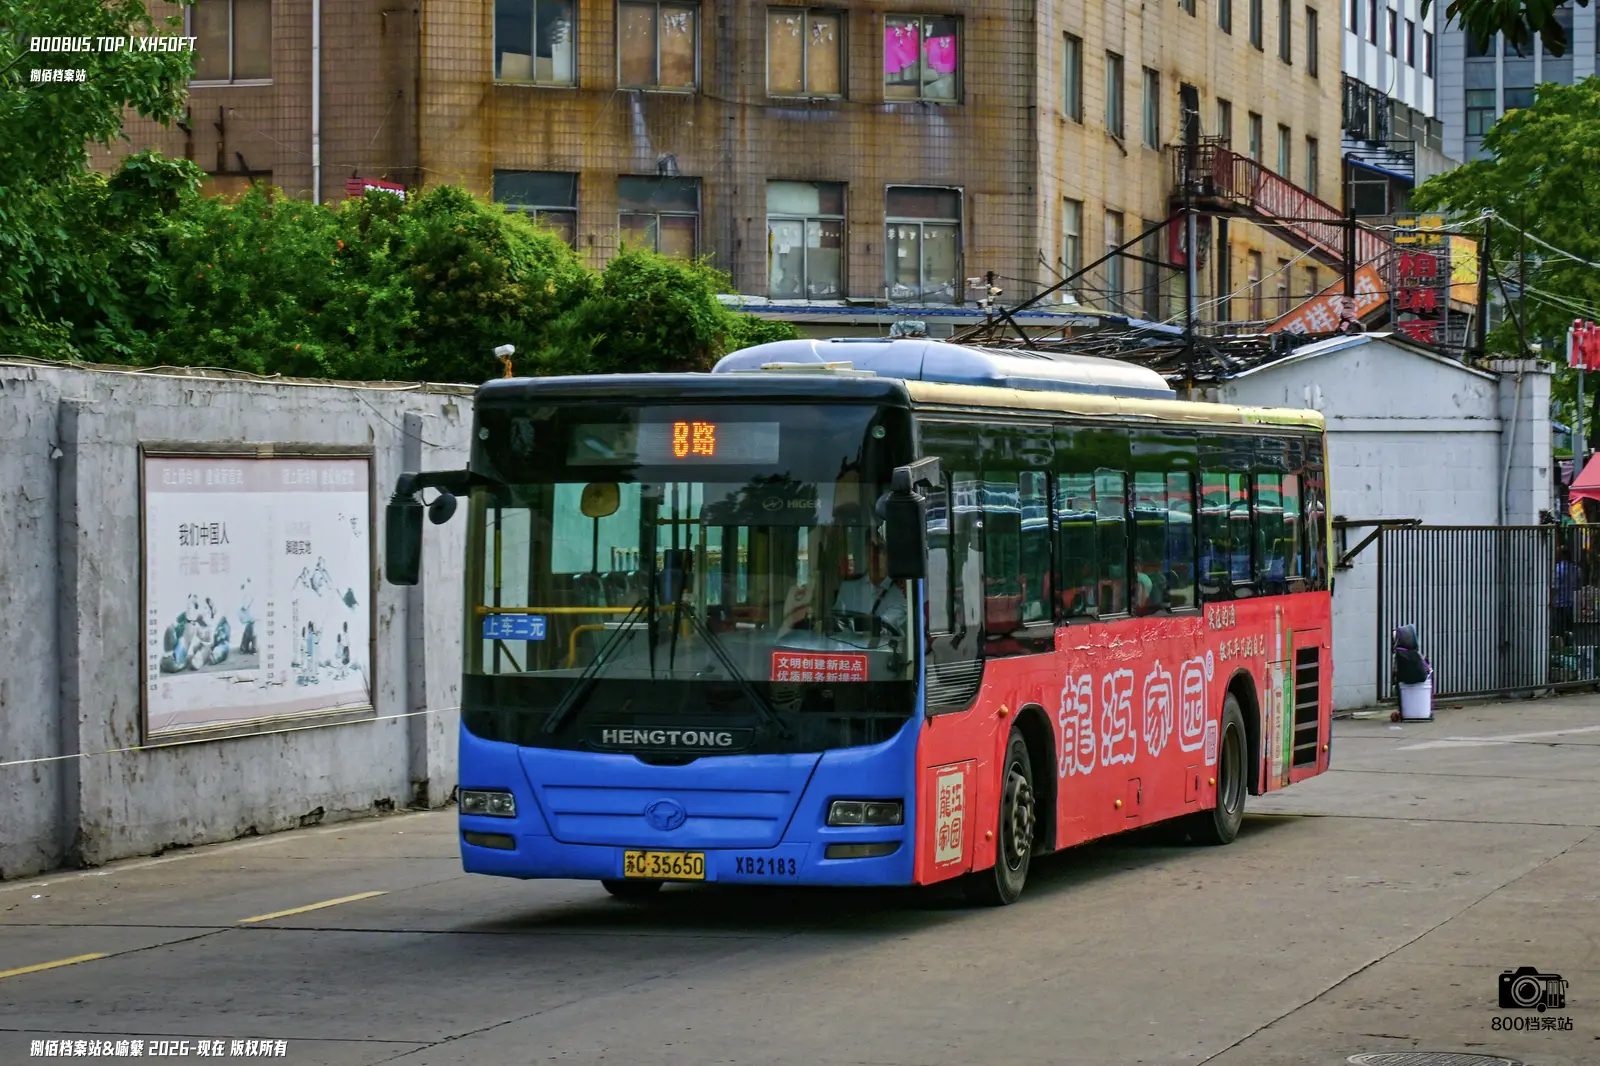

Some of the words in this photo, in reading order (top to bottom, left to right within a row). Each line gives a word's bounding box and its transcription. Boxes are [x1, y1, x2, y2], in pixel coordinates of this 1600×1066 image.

[787, 499, 822, 509] HIGER
[178, 521, 230, 547] 我们中国人
[485, 616, 544, 637] 上车二元
[777, 657, 863, 671] 文明创建新起点
[602, 729, 733, 746] HENGTONG
[736, 856, 796, 875] XB2183
